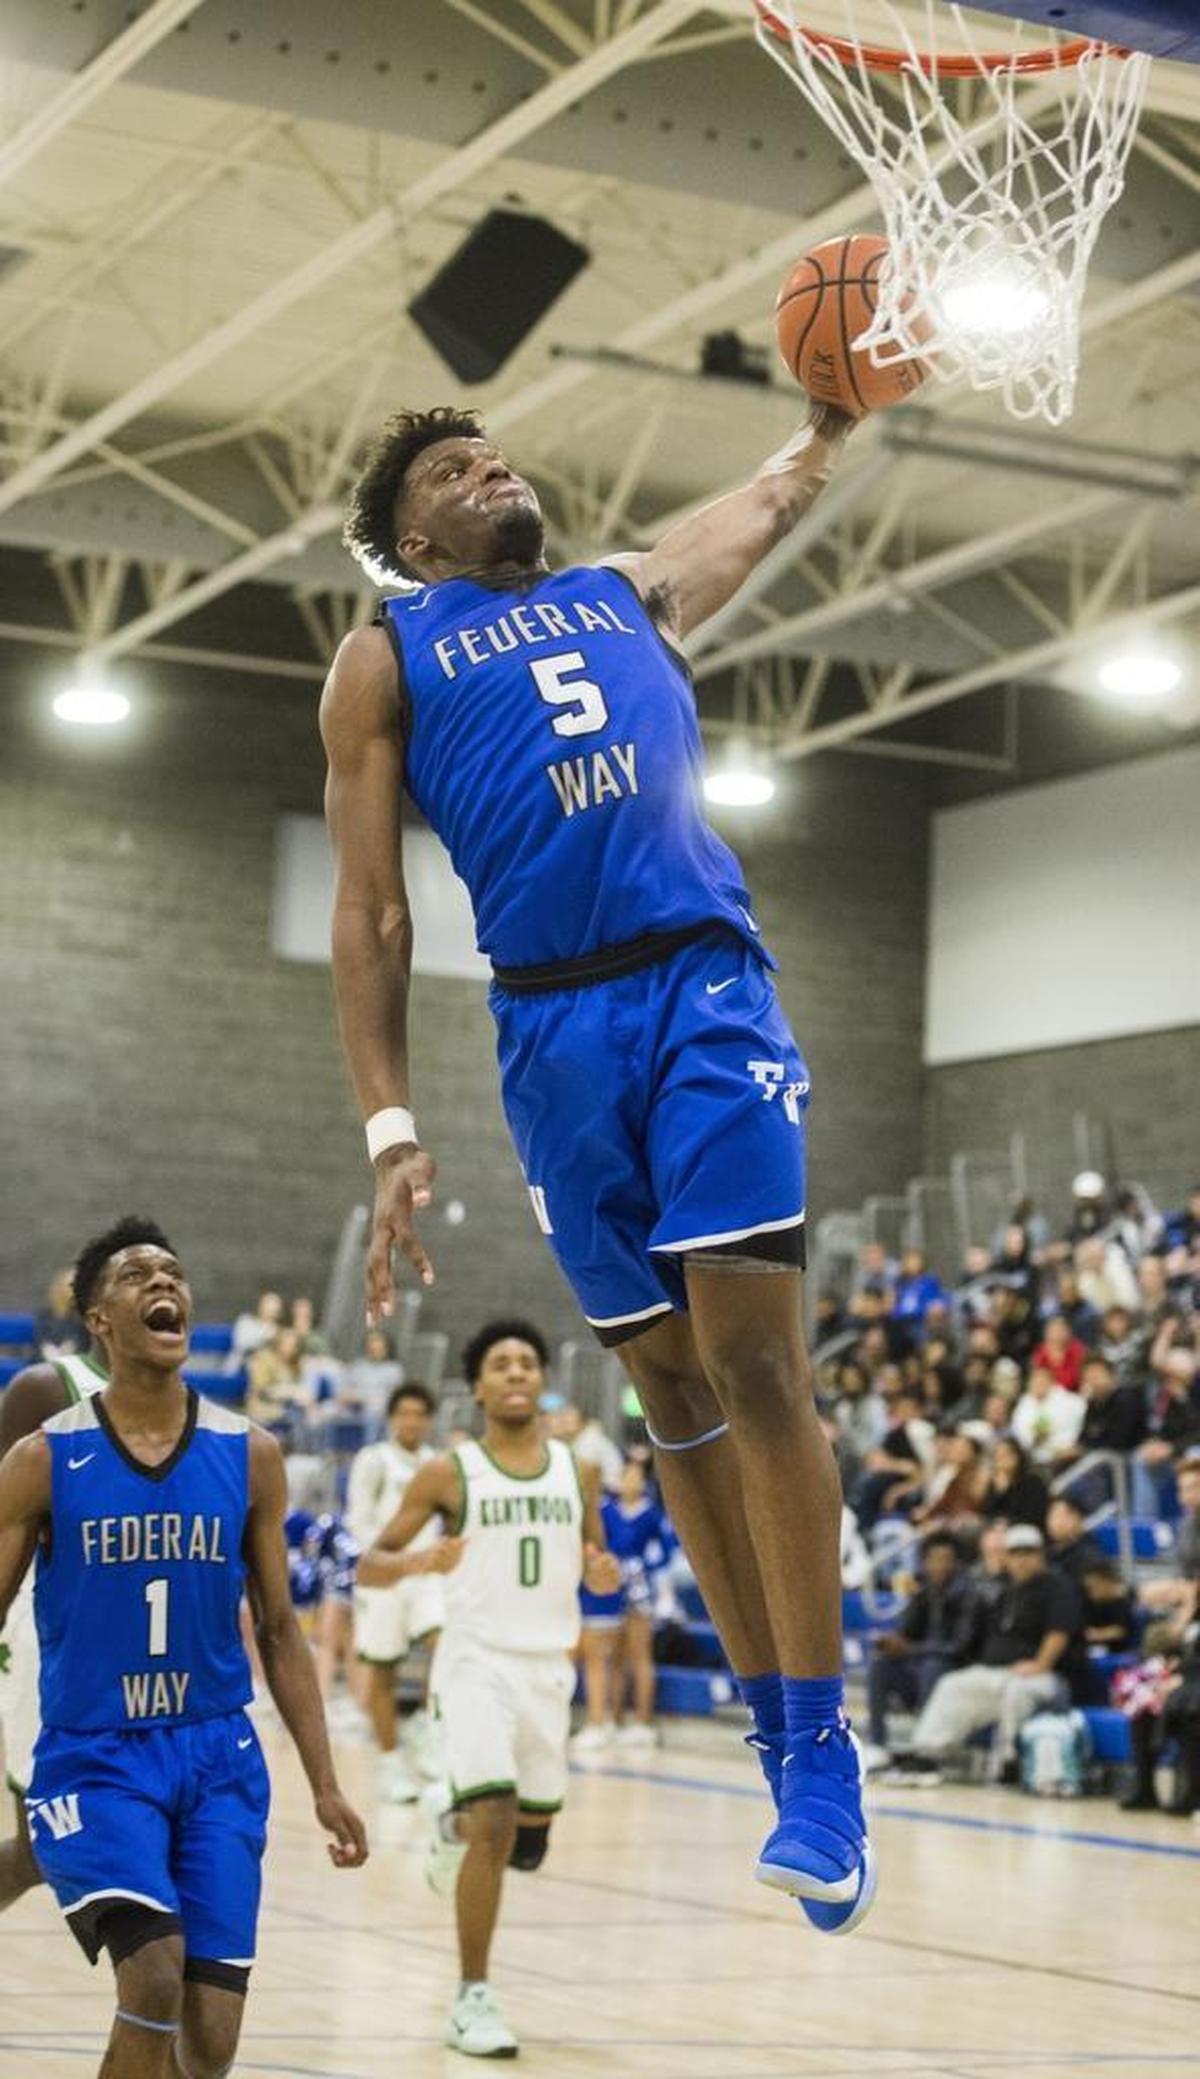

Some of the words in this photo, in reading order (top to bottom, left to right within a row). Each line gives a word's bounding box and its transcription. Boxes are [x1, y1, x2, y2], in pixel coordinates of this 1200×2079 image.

[529, 651, 609, 738] 5
[547, 744, 639, 818] WAY
[81, 1513, 226, 1565] FEDERAL
[519, 1536, 541, 1588] 0
[145, 1578, 169, 1656] 1
[122, 1672, 190, 1719] WAY
